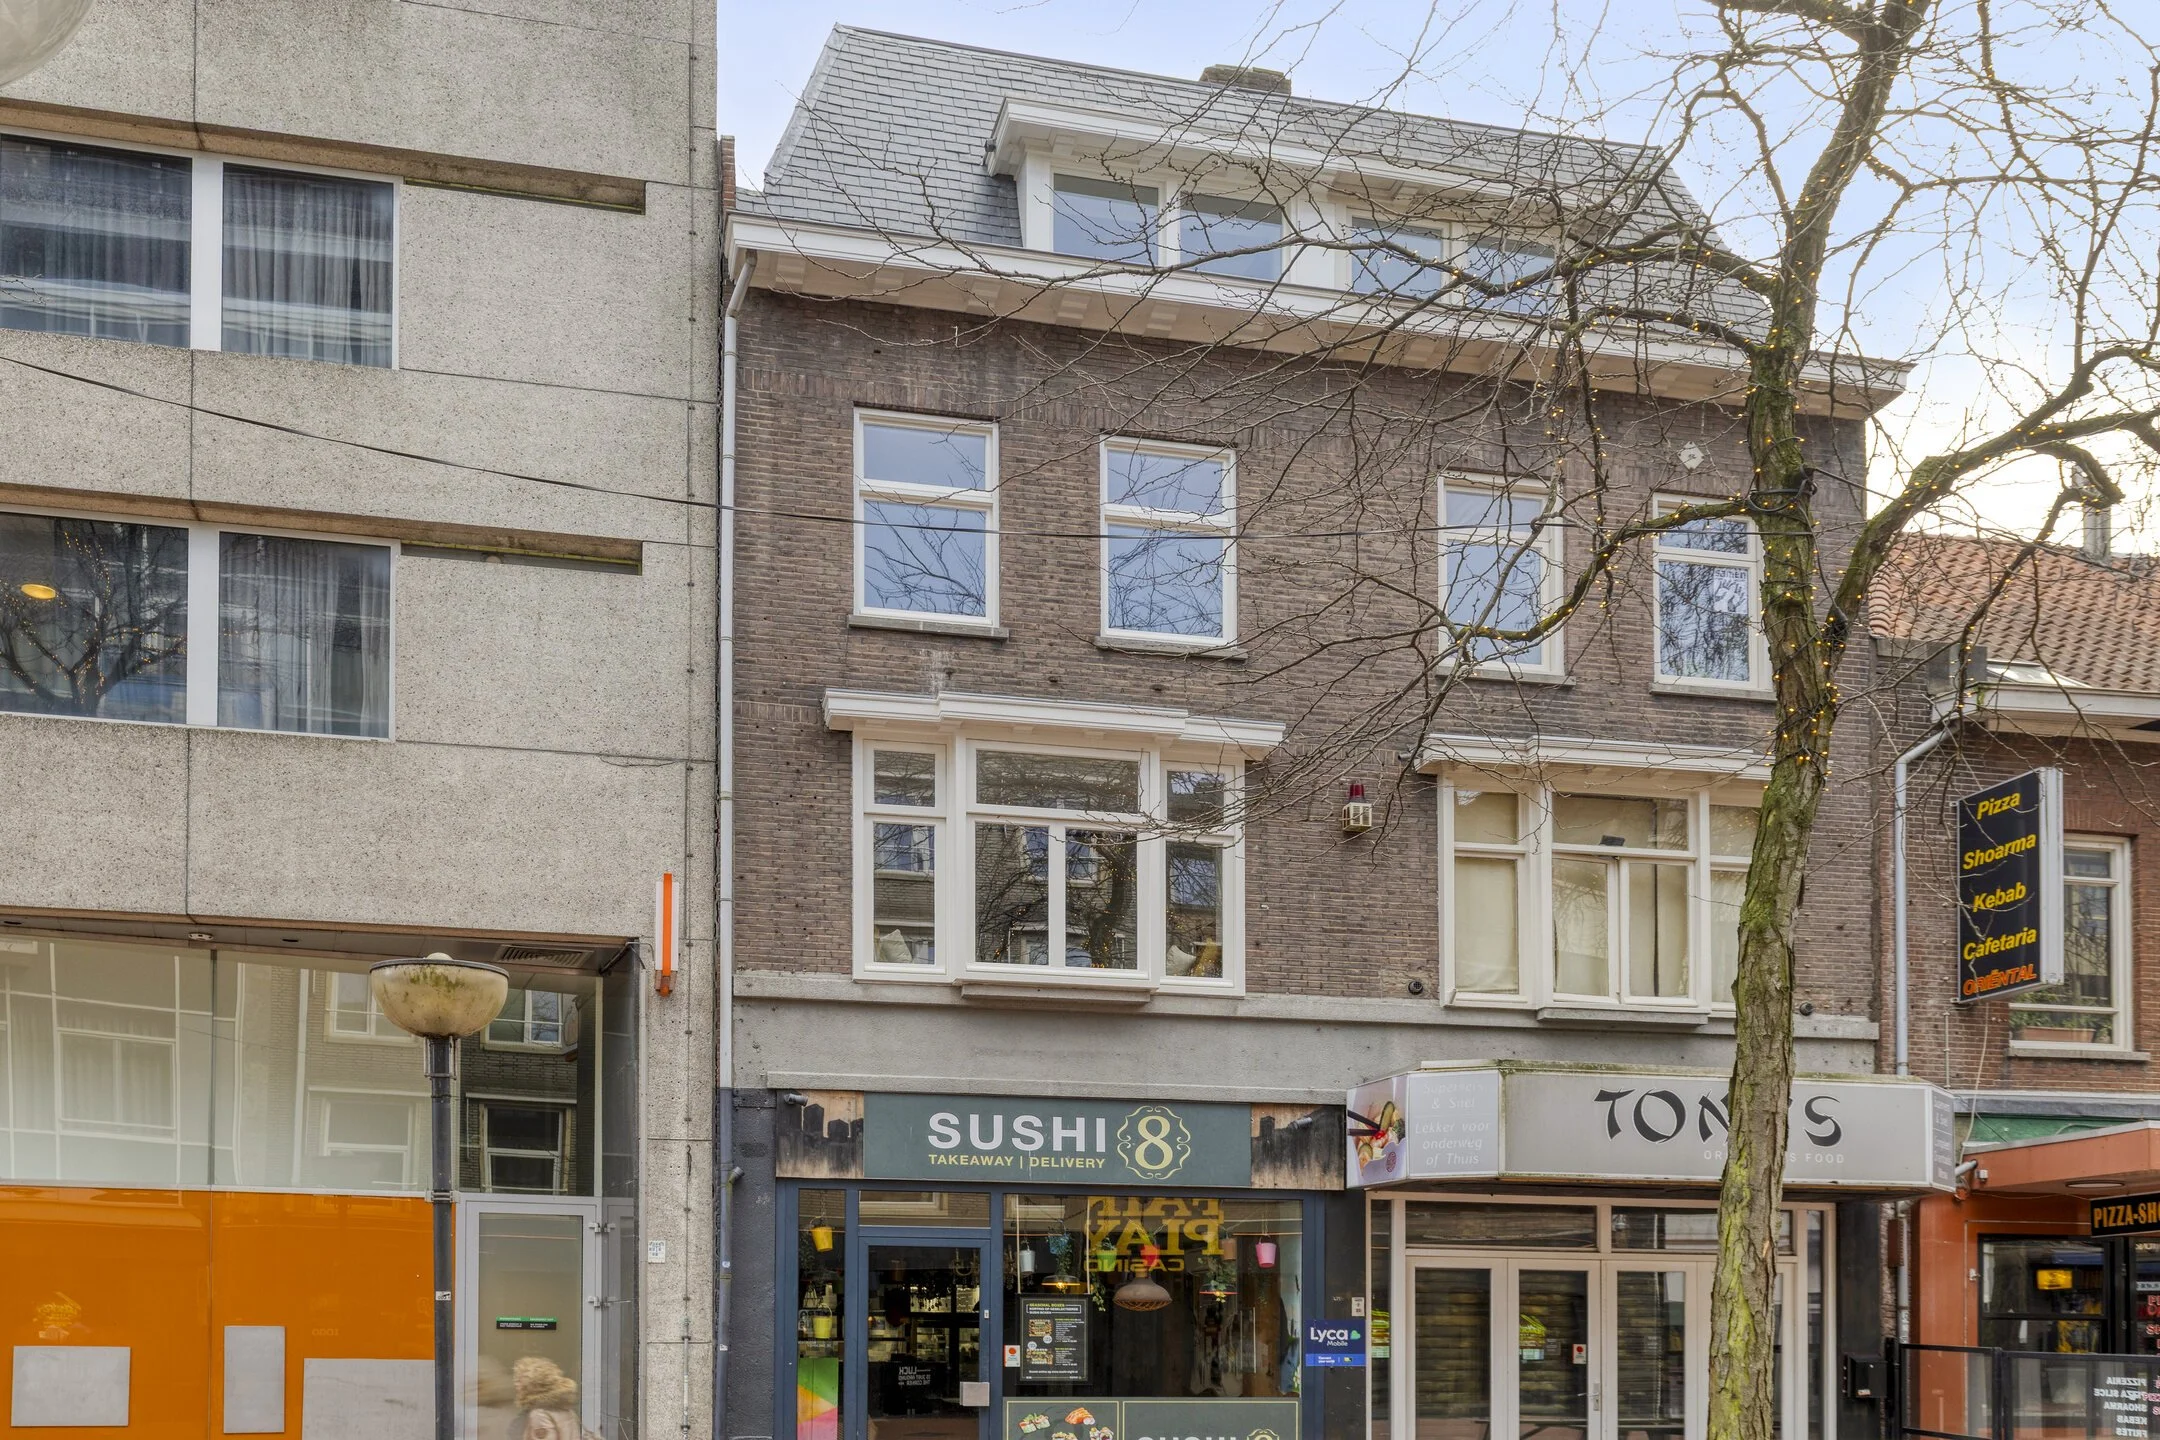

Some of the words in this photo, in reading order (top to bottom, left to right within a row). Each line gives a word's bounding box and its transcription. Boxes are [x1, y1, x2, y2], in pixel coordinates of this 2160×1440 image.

[1976, 792, 2020, 820] Pizza
[1963, 834, 2036, 870] Shoarma
[1973, 882, 2027, 912] Kebab
[1963, 927, 2037, 960] Cafetaria
[928, 1112, 1106, 1152] SUSHI
[1135, 1115, 1173, 1170] 8
[1415, 1122, 1455, 1134] Lekker
[1462, 1122, 1490, 1132] voor
[1422, 1136, 1483, 1150] onderweg
[928, 1154, 1014, 1167] TAKEAWAY
[1029, 1156, 1106, 1169] DELIVERY
[1805, 1153, 1845, 1164] FOOD
[2093, 1201, 2160, 1229] PIZZA-SH
[1310, 1327, 1349, 1342] Lyca
